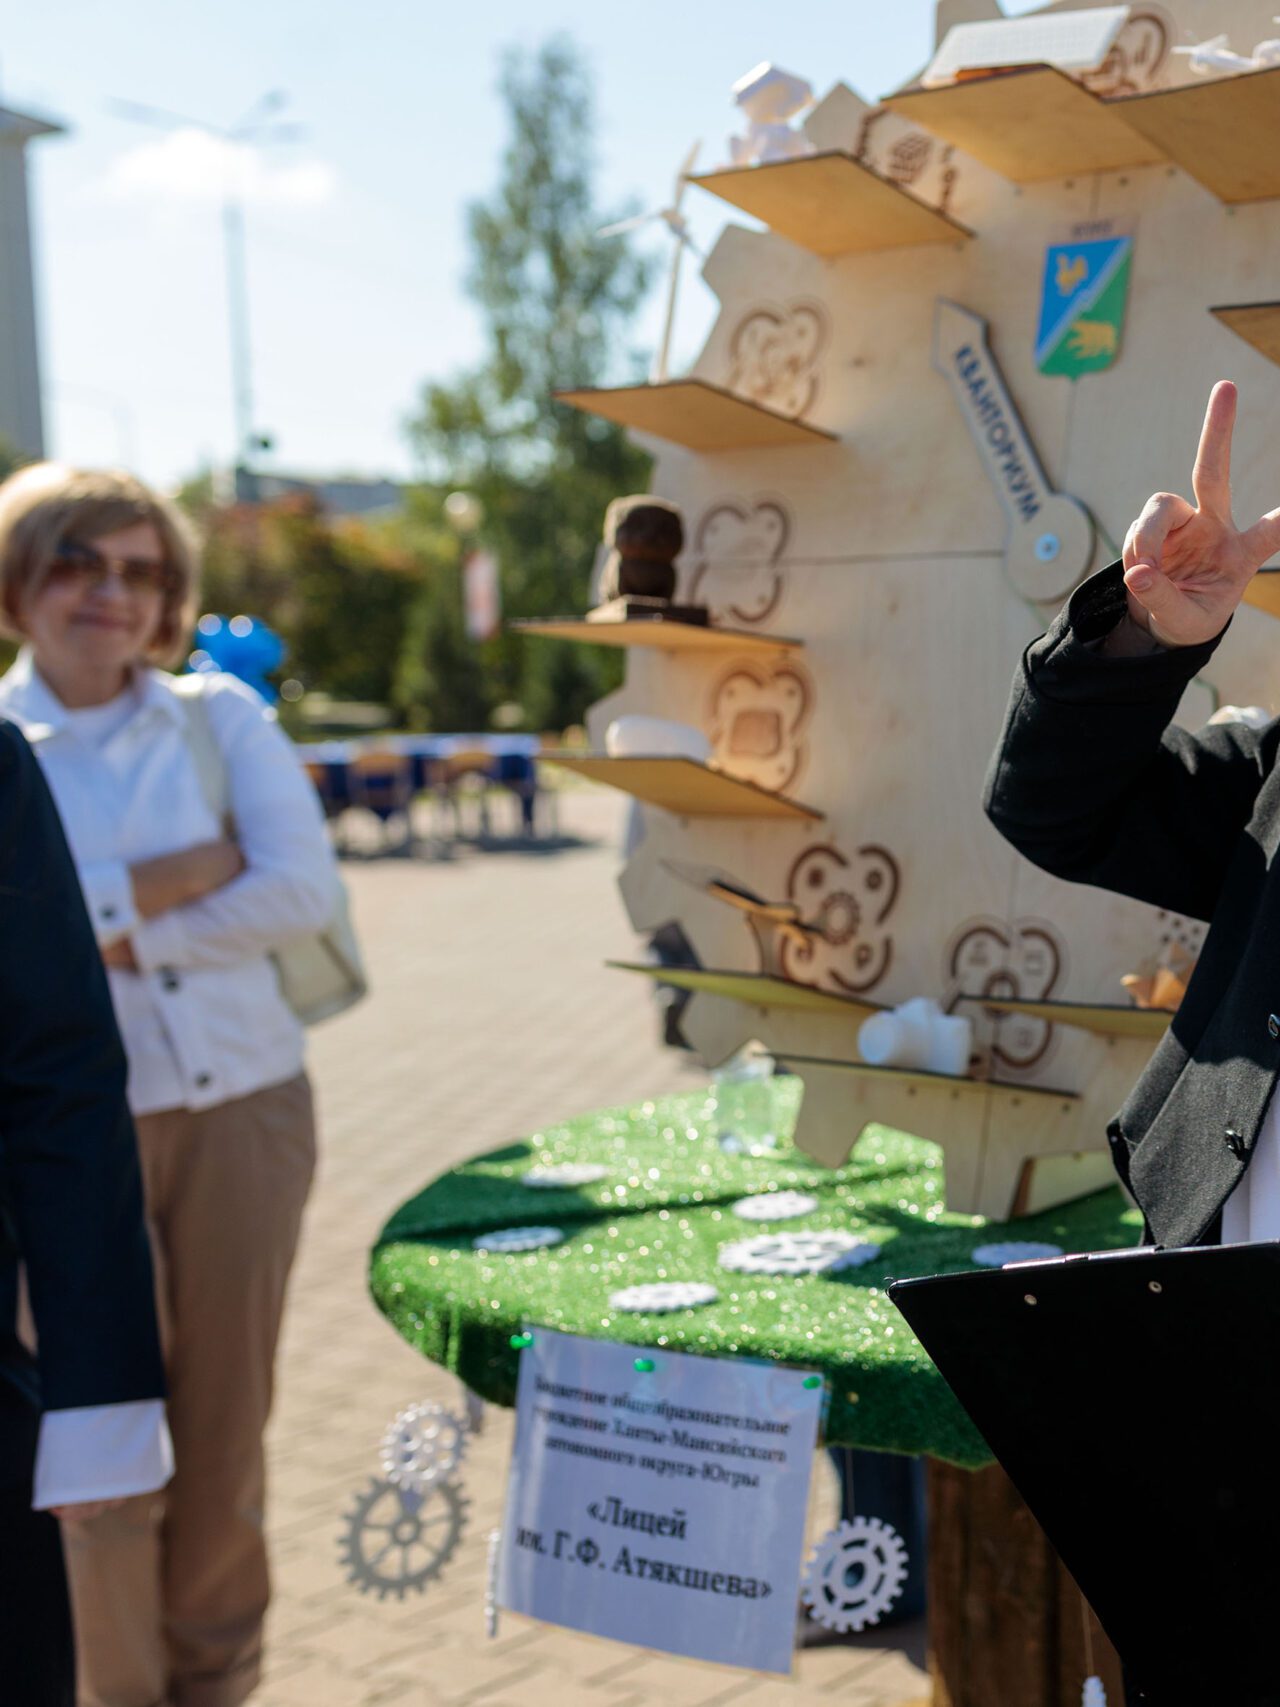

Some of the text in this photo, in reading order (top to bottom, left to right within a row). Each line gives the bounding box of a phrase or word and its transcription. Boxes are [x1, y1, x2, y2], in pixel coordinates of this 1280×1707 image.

[955, 344, 1041, 523] КВАНТОРИУМ
[587, 1496, 688, 1540] «Лицей
[553, 1529, 606, 1569] Г.Ф.
[612, 1546, 773, 1599] Атякшева»
